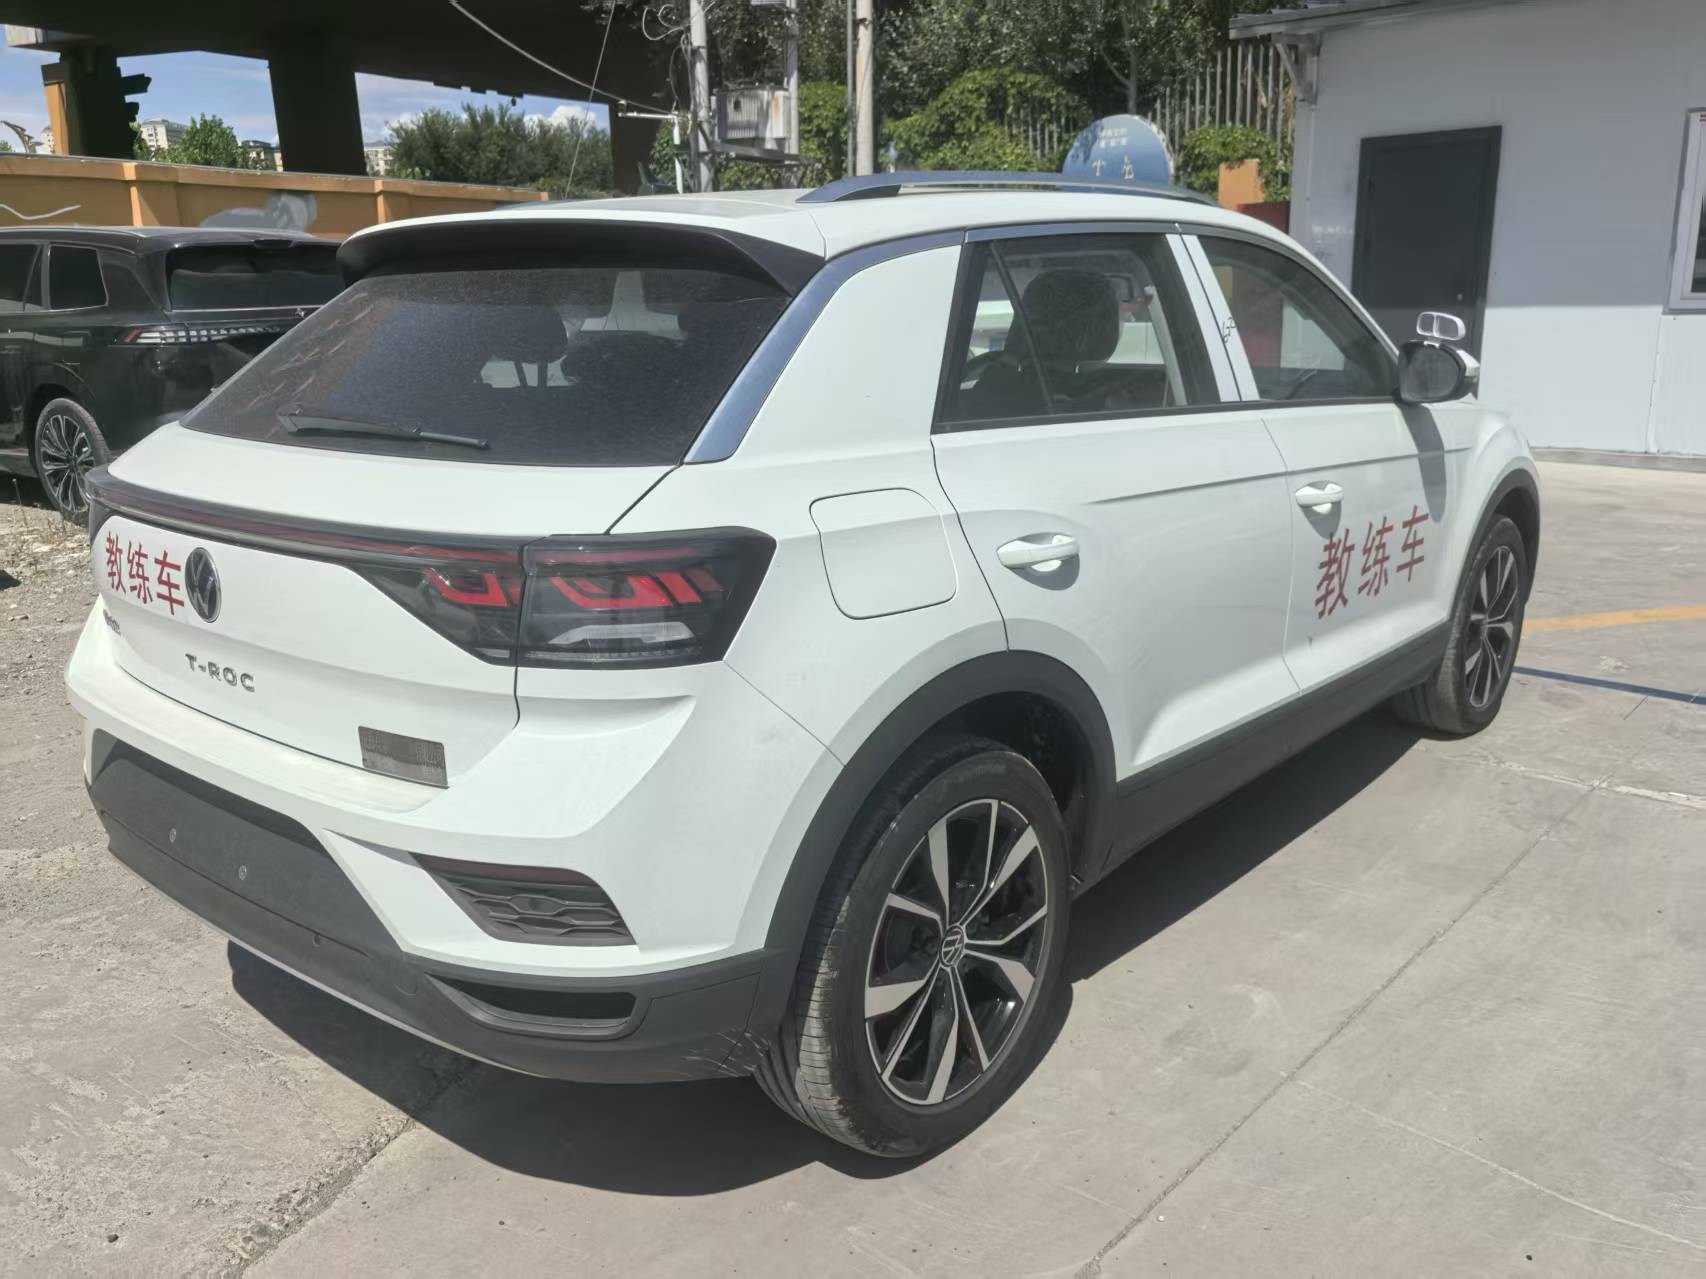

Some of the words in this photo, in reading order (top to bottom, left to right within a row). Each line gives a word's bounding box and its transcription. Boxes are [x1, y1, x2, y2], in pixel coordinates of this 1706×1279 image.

[105, 531, 185, 616] 教练车
[1315, 505, 1429, 619] 教练车
[185, 653, 255, 692] T-ROC
